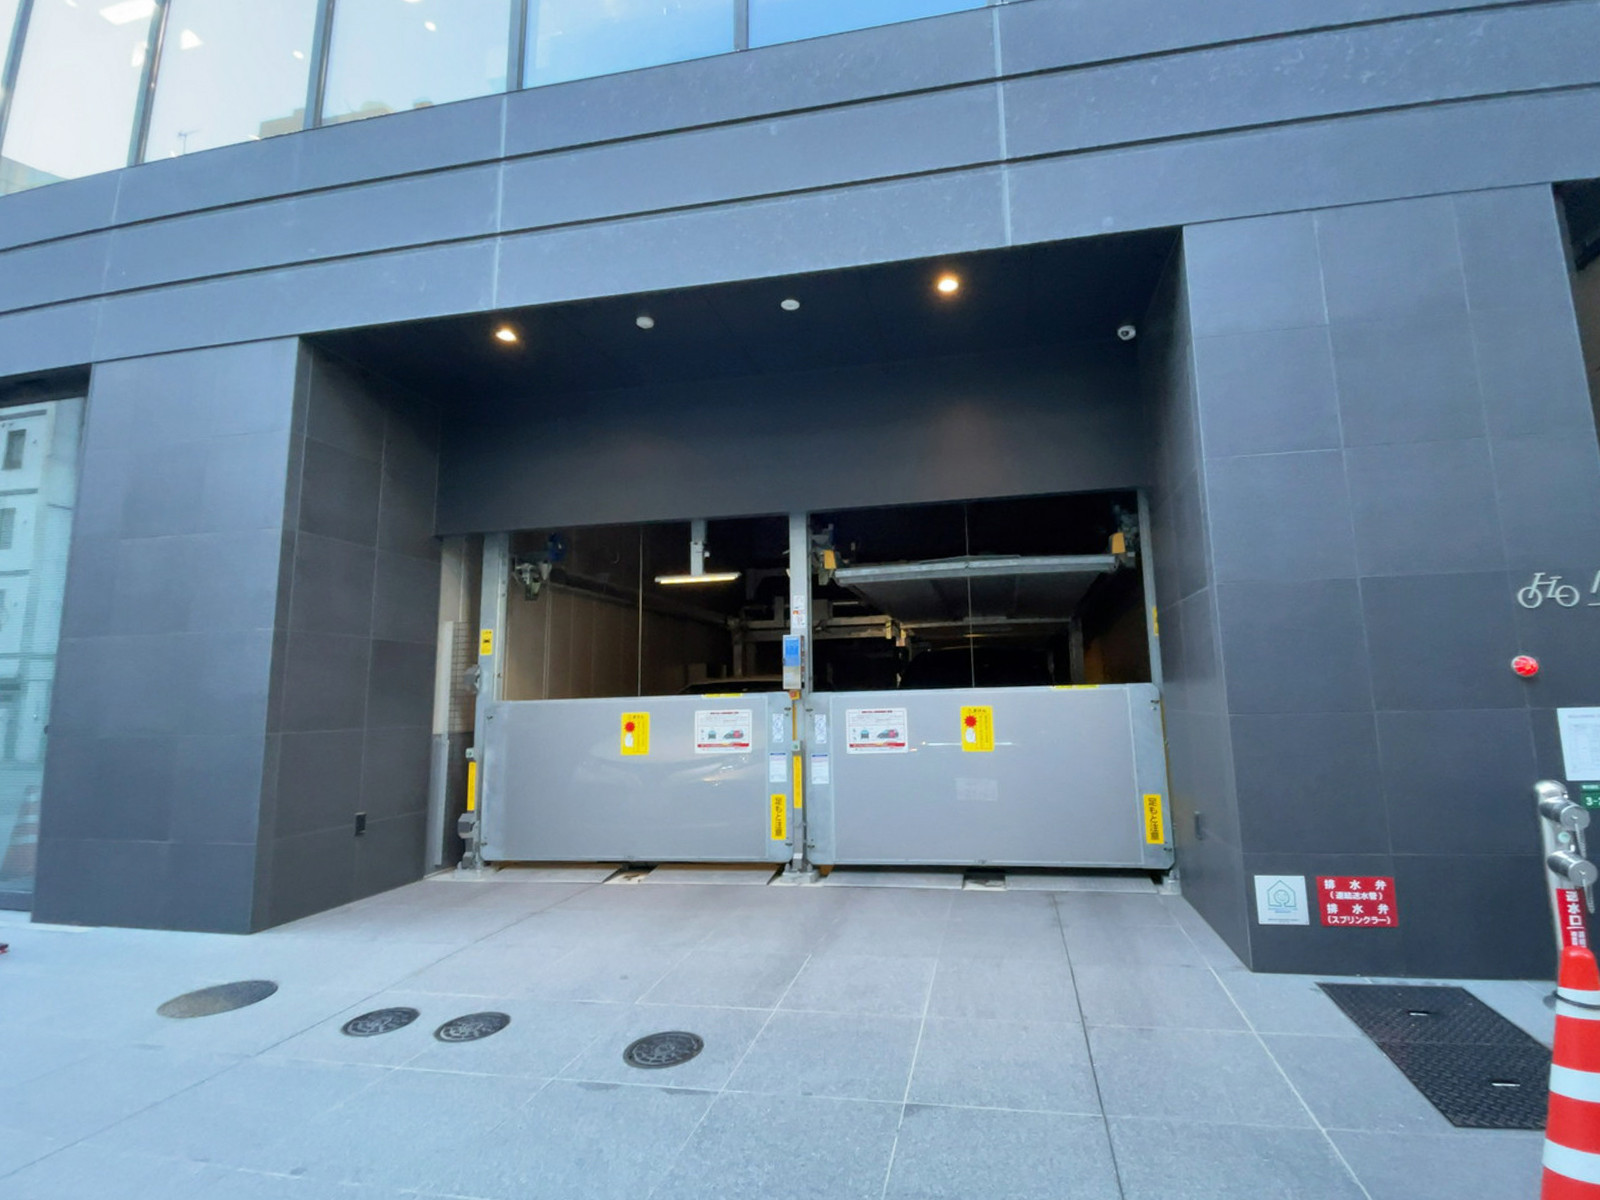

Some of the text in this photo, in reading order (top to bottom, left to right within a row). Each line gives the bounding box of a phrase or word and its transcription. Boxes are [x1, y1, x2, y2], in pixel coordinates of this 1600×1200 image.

[1327, 916, 1392, 925] (スプリンクラー)
